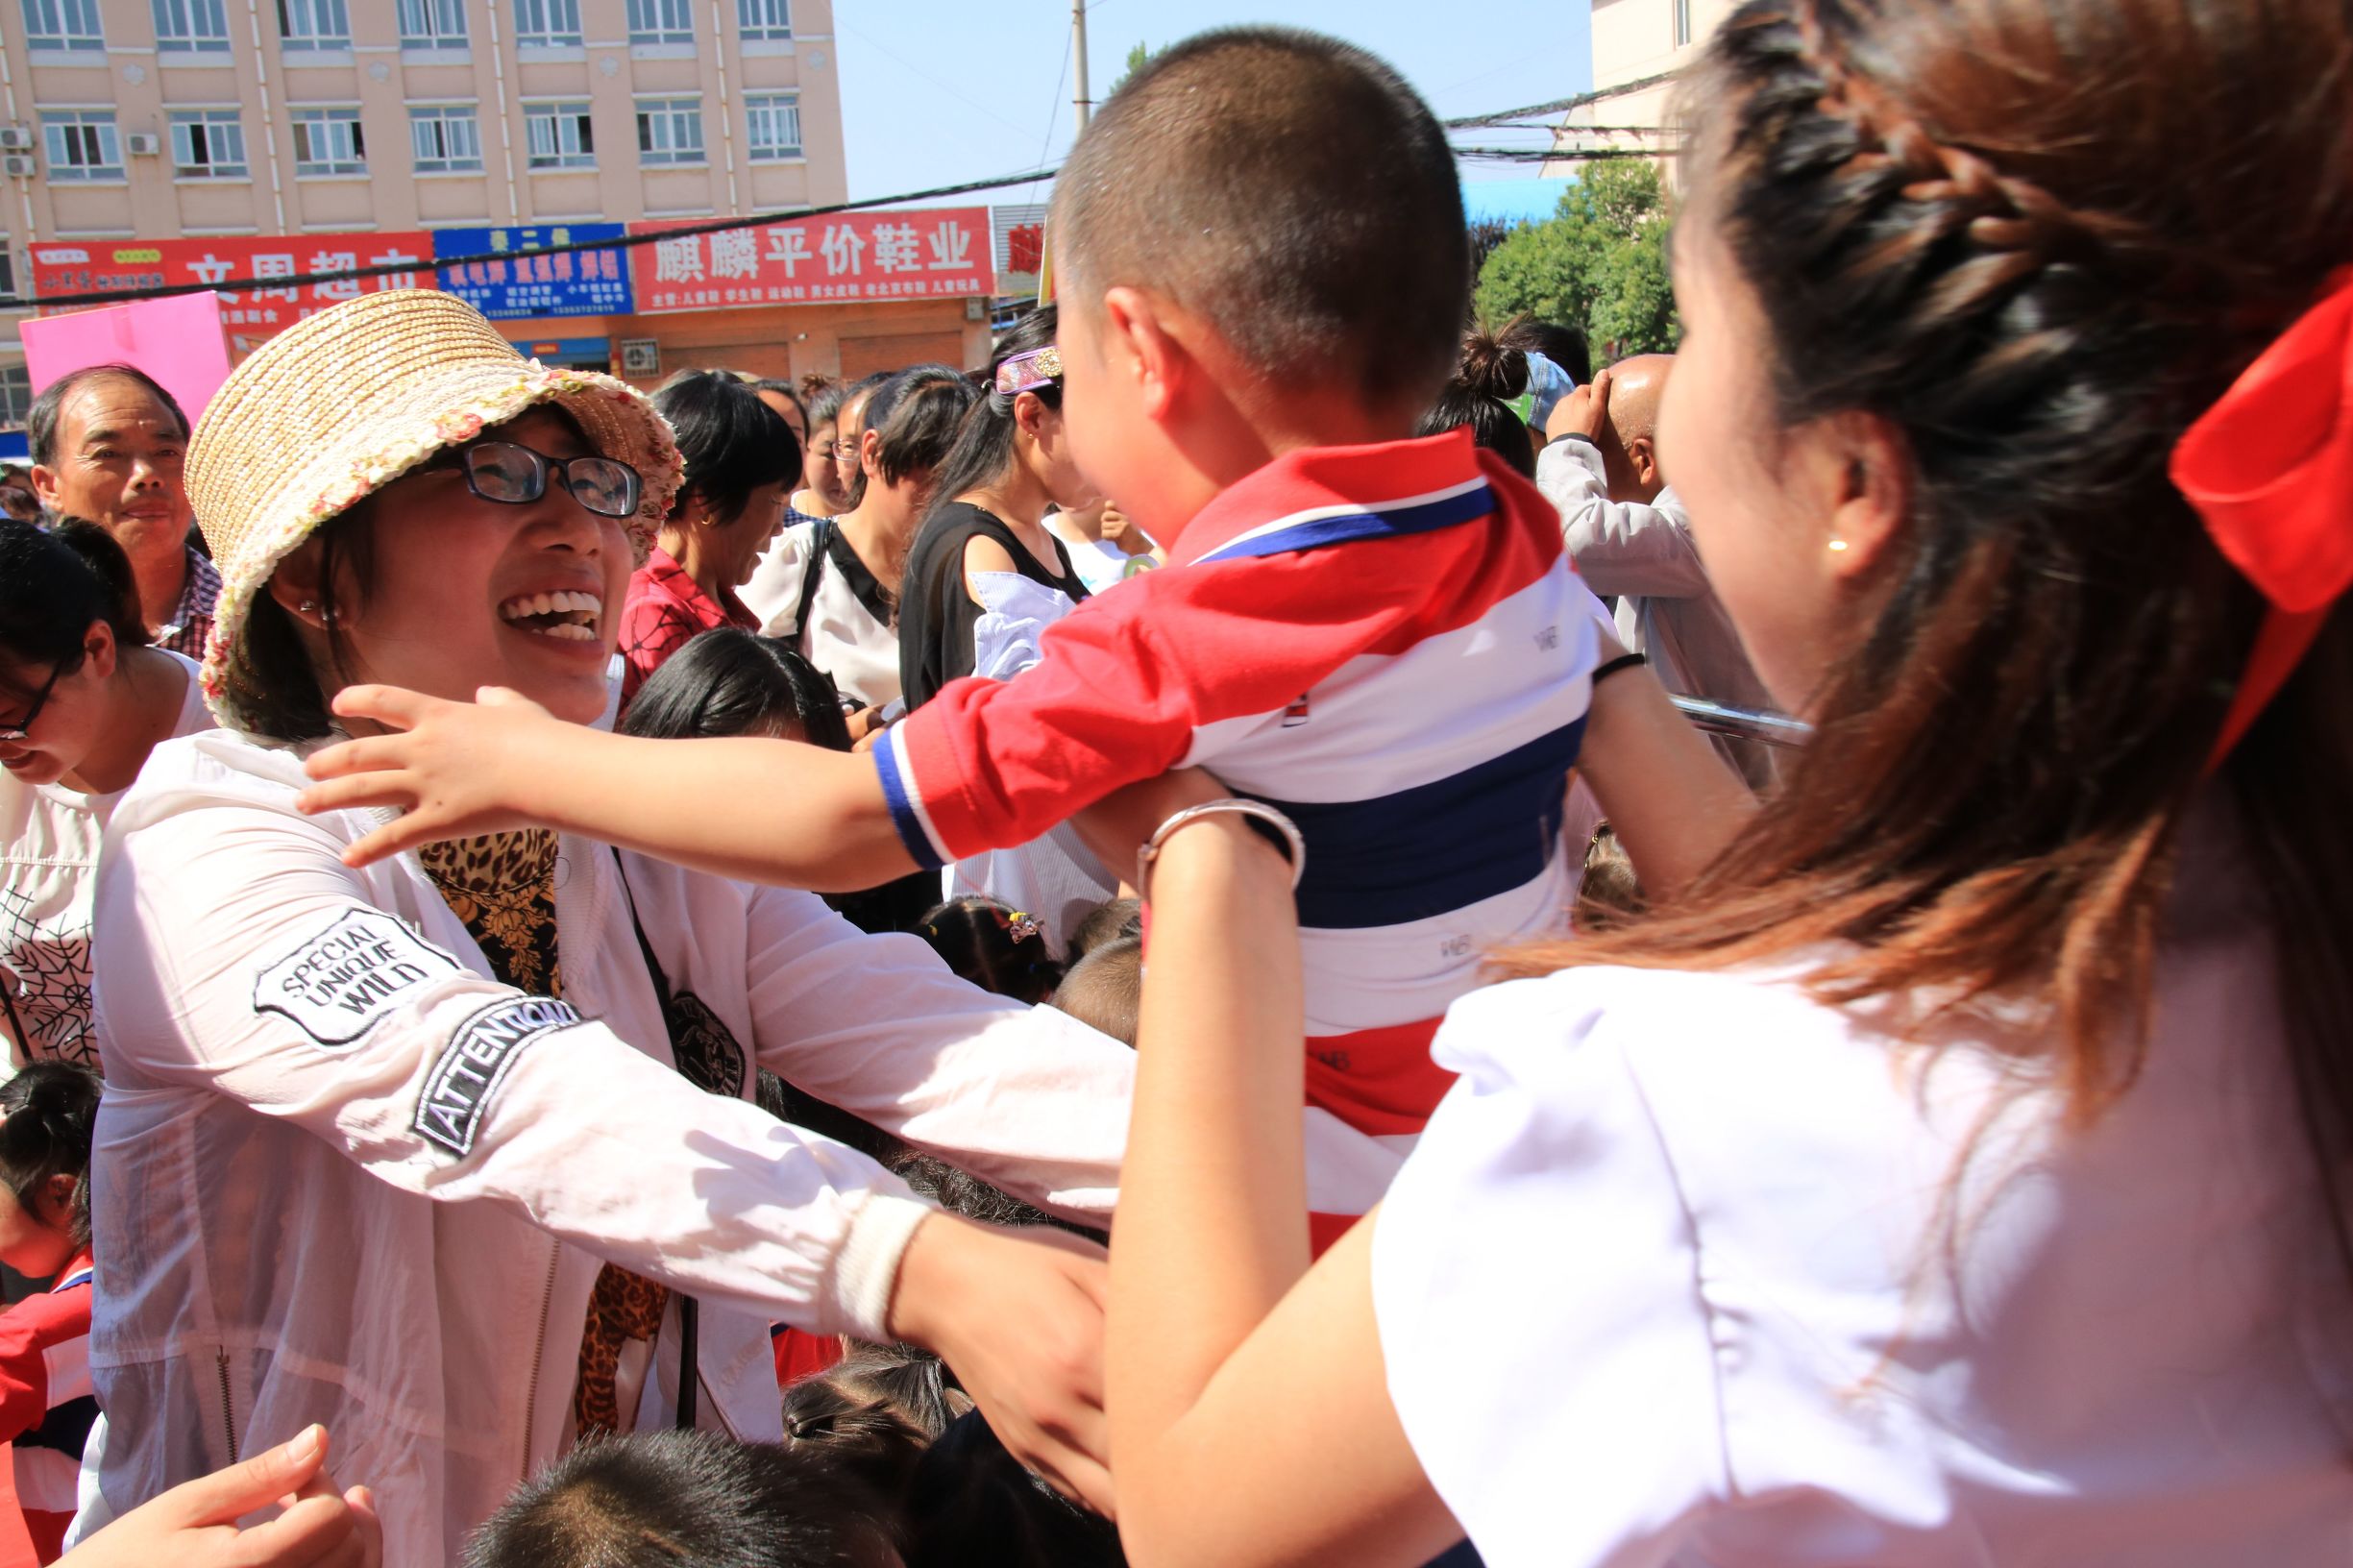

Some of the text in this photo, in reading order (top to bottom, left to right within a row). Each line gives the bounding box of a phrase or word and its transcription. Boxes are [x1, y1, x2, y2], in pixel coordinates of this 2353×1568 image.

[655, 221, 974, 282] 麒麟平价鞋业
[282, 924, 380, 999] SPECIAL
[305, 938, 404, 1007] UNIQUE
[337, 963, 429, 1016] WILD
